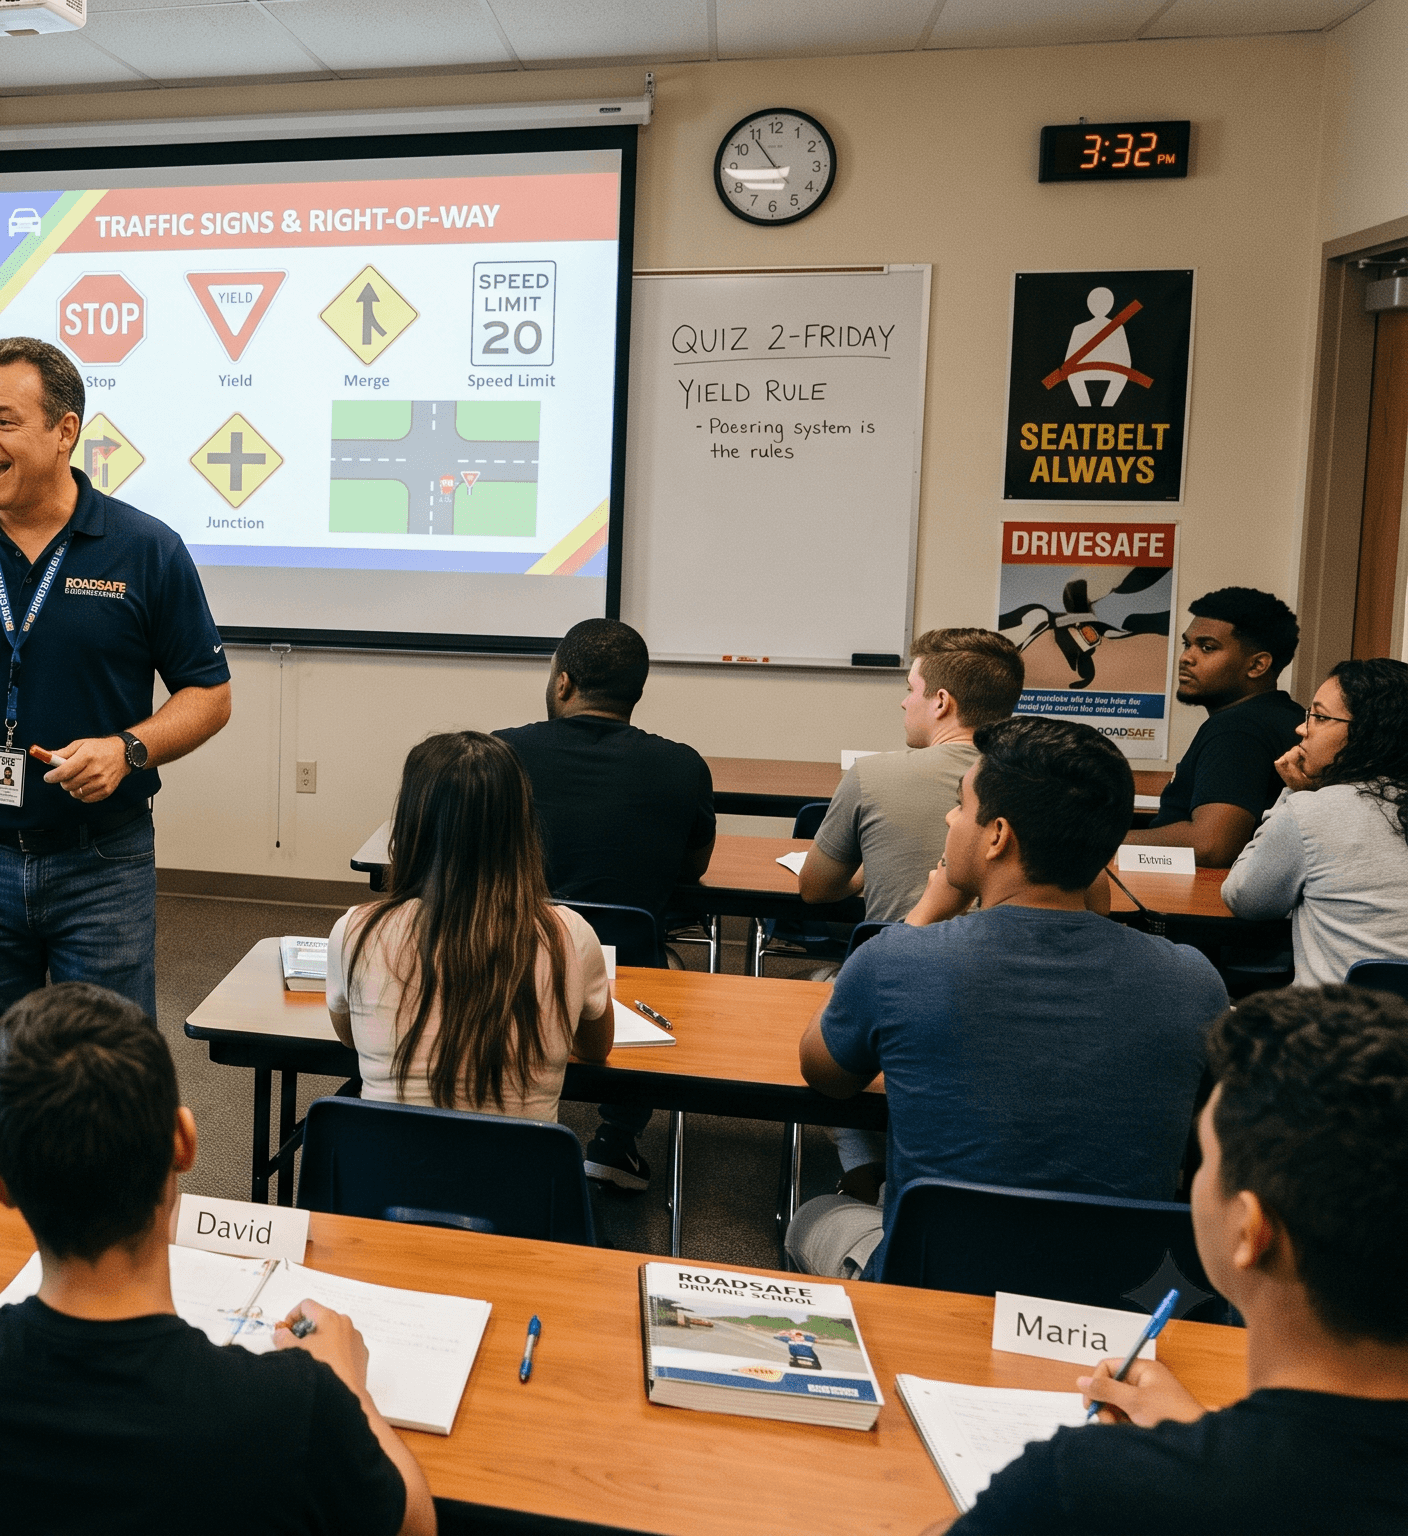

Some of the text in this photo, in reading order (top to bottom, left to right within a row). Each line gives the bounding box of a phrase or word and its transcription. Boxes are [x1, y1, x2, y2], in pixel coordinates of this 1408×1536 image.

[750, 128, 761, 140] 11
[768, 121, 783, 134] 12
[794, 127, 800, 138] 1
[734, 143, 749, 156] 10
[807, 140, 816, 152] 2
[1080, 132, 1175, 168] 3:32 PM
[729, 162, 738, 170] 9
[812, 161, 821, 172] 3
[734, 182, 743, 193] 8
[805, 180, 813, 192] 4
[750, 195, 758, 206] 7
[768, 200, 777, 212] 6
[790, 194, 799, 206] 5
[95, 204, 500, 238] TRAFFIC SIGNS & RIGHT-OF-WAY
[479, 273, 549, 290] SPEED
[218, 292, 253, 303] YIELD
[485, 297, 542, 312] LIMIT
[64, 302, 140, 336] STOP
[482, 320, 543, 355] 20
[672, 324, 749, 353] QUIZ
[86, 376, 116, 390] Stop
[218, 374, 253, 387] Yield
[344, 374, 390, 390] Merge
[467, 374, 555, 390] Speed Limit
[678, 379, 827, 409] YIELD RULE
[794, 420, 851, 440] system
[861, 420, 875, 433] is
[1020, 422, 1170, 450] SEATBELT
[711, 443, 794, 458] the rules
[1029, 456, 1155, 483] ALWAYS
[206, 516, 264, 529] Junction
[1011, 531, 1165, 558] DRIVESAFE
[65, 578, 126, 593] ROADSAFE
[197, 1211, 272, 1244] David
[678, 1273, 812, 1298] ROADSAFE
[679, 1283, 745, 1297] DRIVING
[1016, 1312, 1108, 1351] Maria
